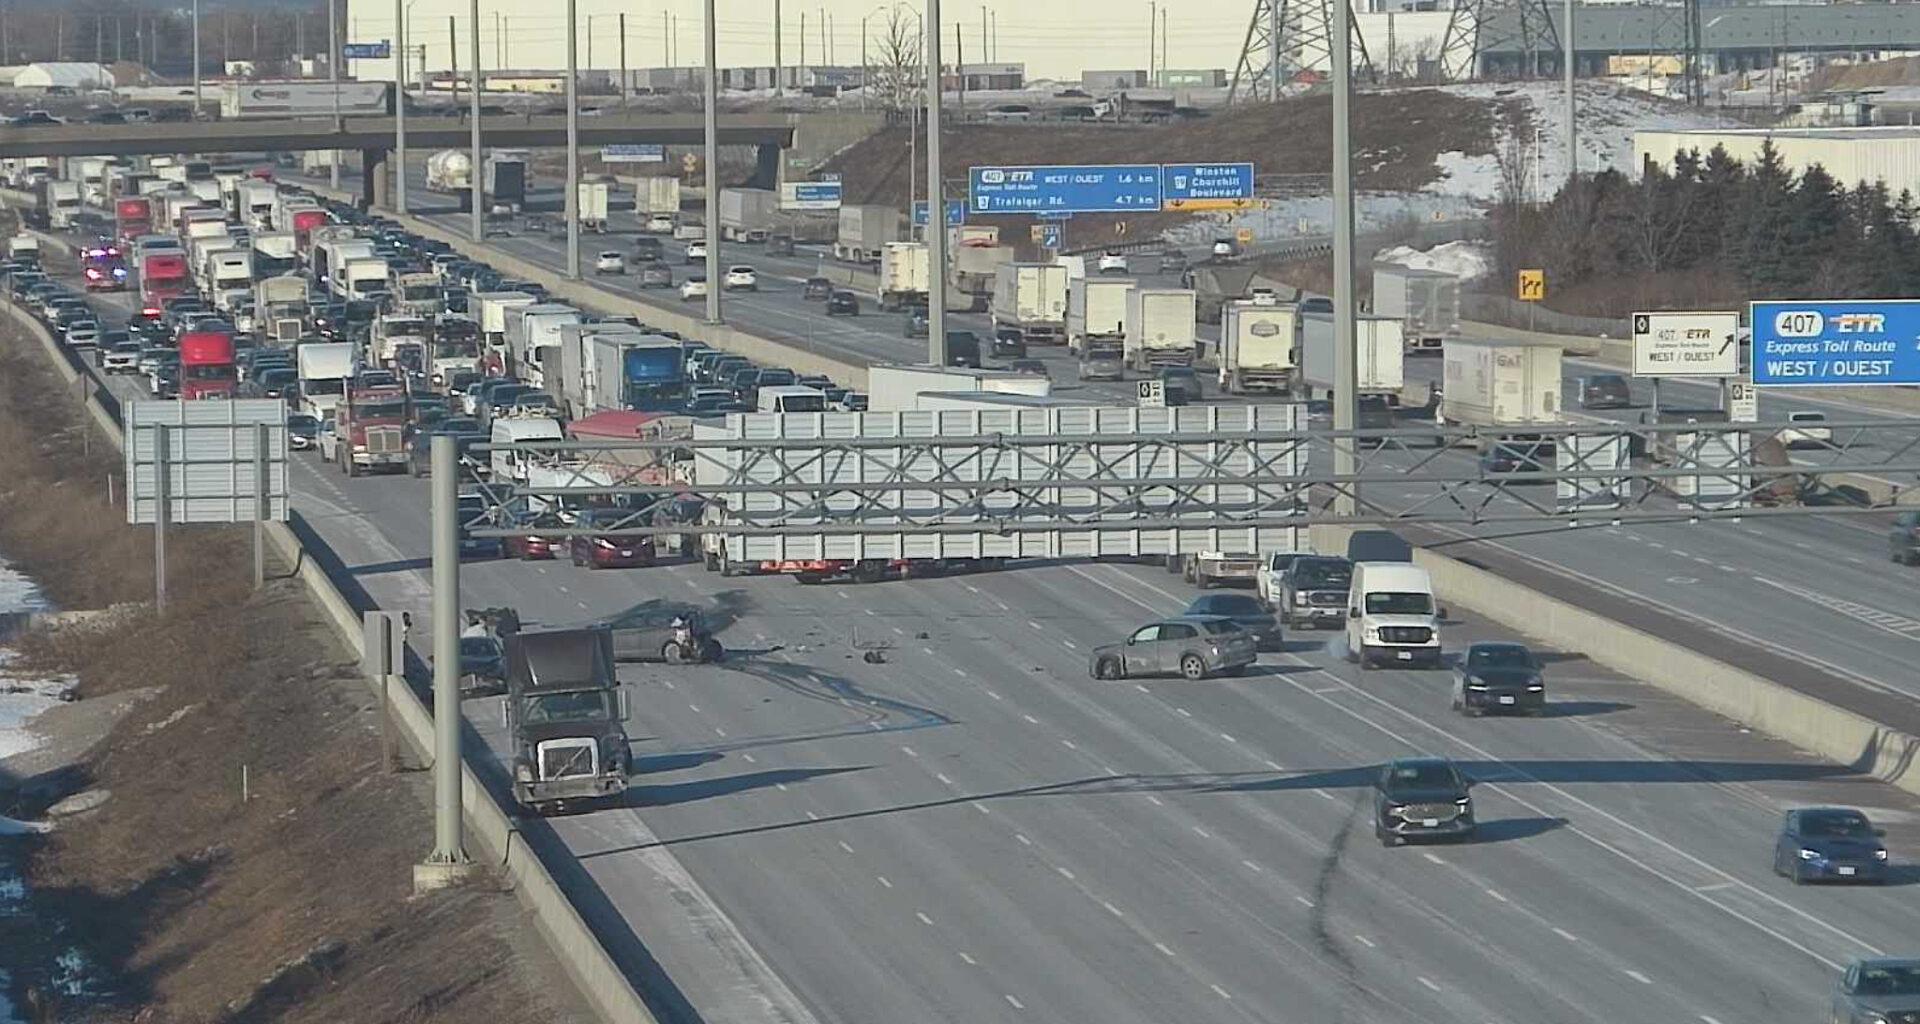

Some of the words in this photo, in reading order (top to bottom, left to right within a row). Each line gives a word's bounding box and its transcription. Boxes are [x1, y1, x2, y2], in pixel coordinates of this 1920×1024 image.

[1195, 167, 1237, 176] Winston
[1045, 174, 1068, 183] WEST
[1075, 174, 1104, 183] OUEST
[1118, 174, 1133, 183] 1.6
[1138, 174, 1154, 183] km
[1192, 177, 1240, 186] Churchill
[1190, 188, 1242, 197] Boulevard
[995, 197, 1042, 207] Trafalgar
[1049, 196, 1065, 205] Rd.
[1115, 195, 1132, 204] 4.7
[1138, 195, 1154, 204] km
[1781, 314, 1817, 333] 407
[1838, 313, 1886, 333] ETR
[1686, 329, 1711, 339] ETR
[1766, 340, 1819, 355] Express
[1824, 340, 1849, 353] Toll
[1854, 340, 1897, 353] Route
[1649, 352, 1674, 362] WEST
[1684, 352, 1715, 361] OUEST
[1767, 360, 1817, 377] WEST
[1821, 360, 1829, 378] /
[1834, 360, 1893, 376] OUEST
